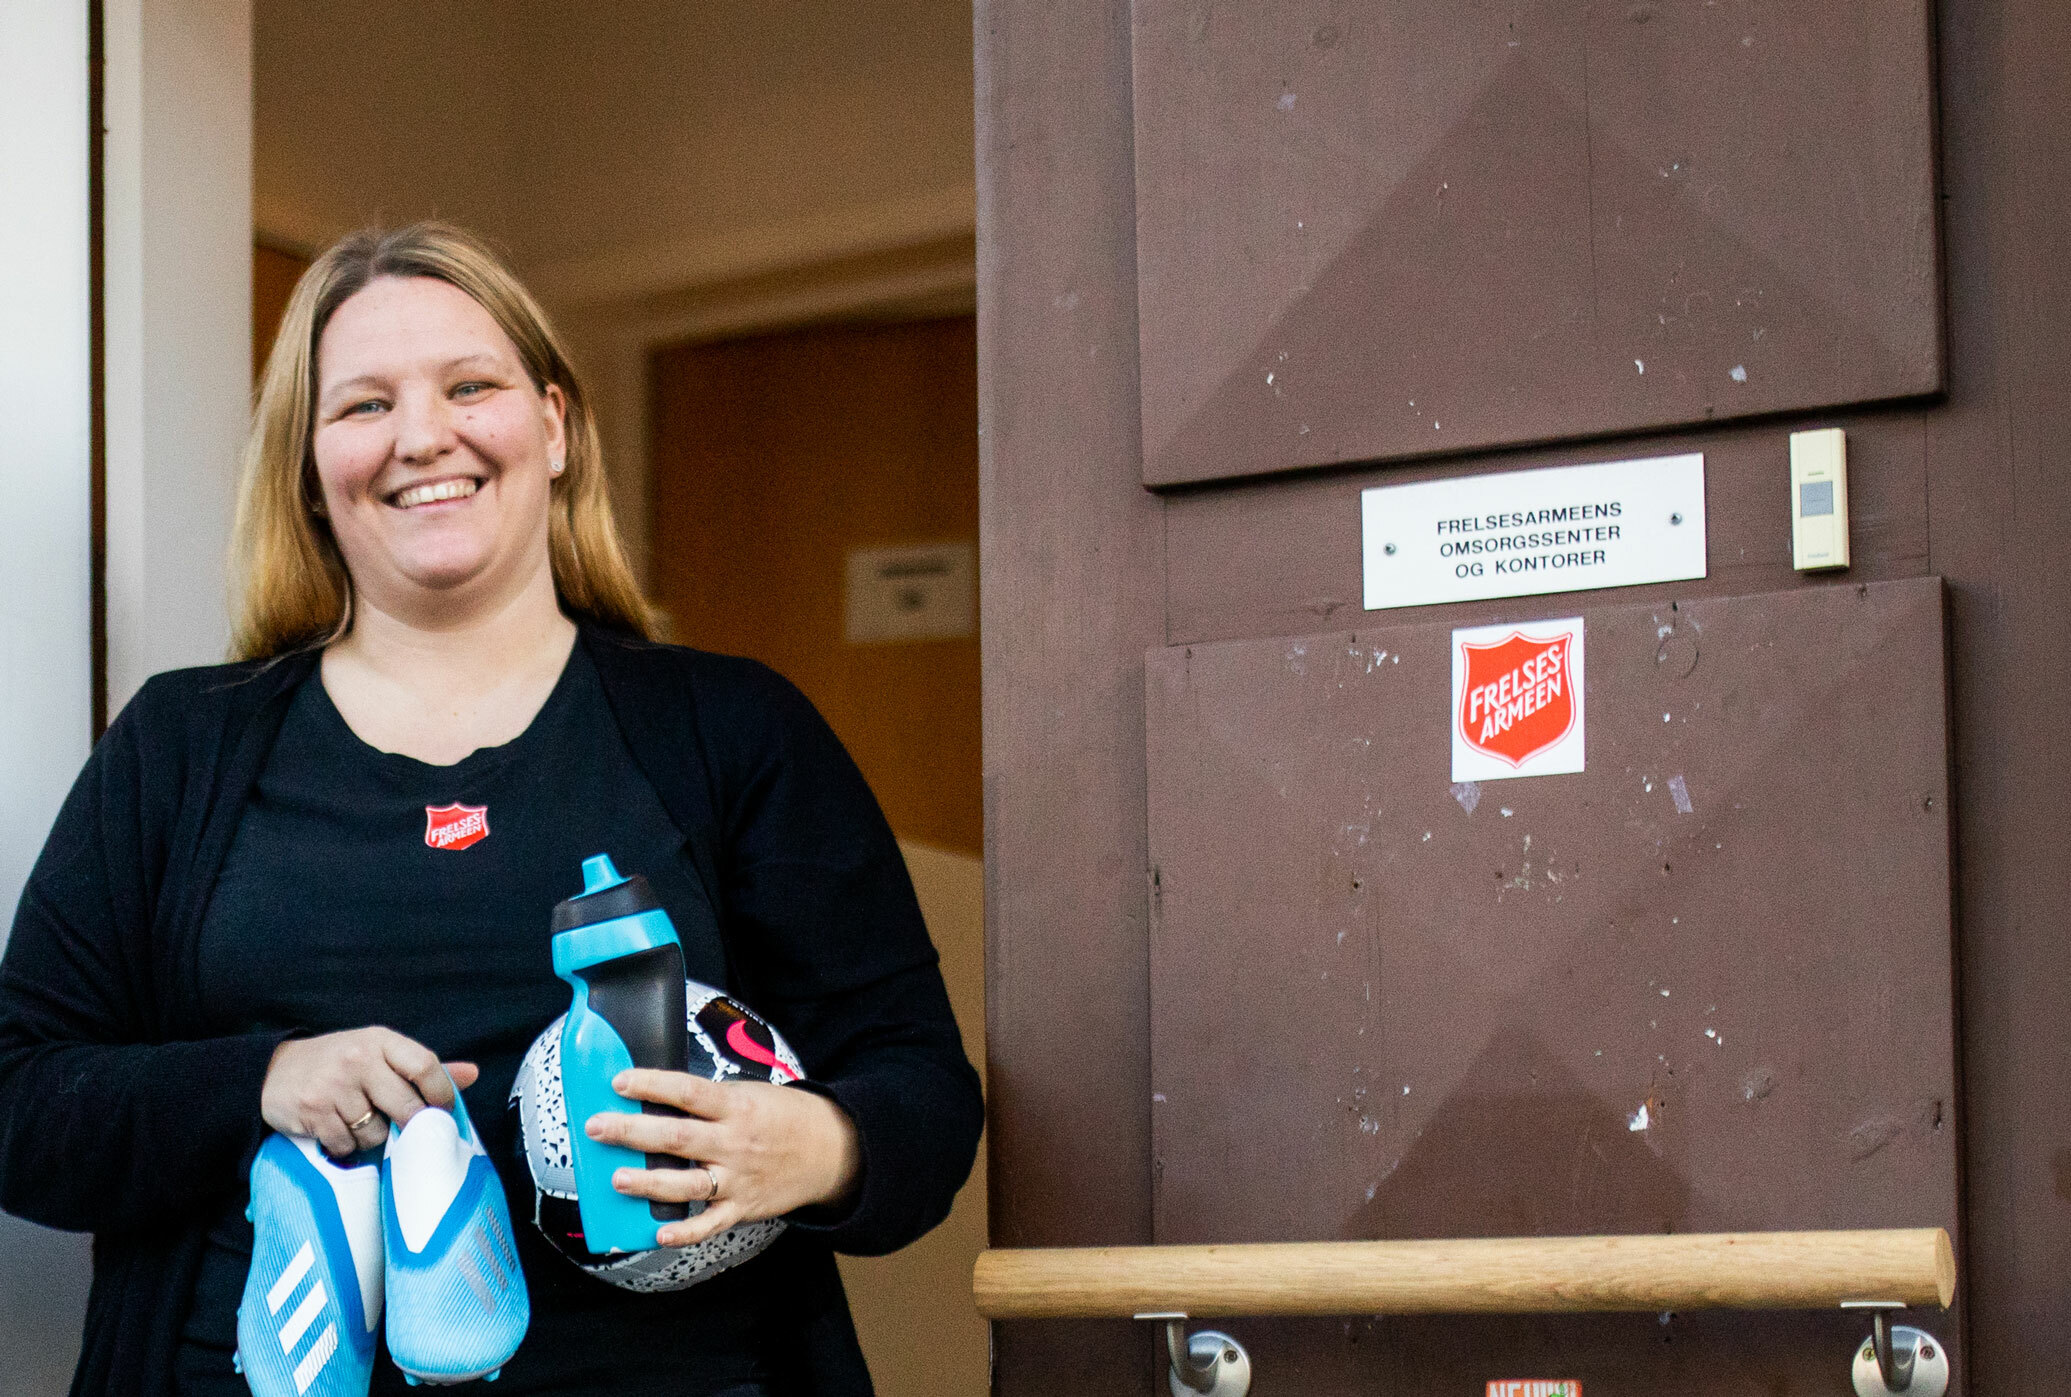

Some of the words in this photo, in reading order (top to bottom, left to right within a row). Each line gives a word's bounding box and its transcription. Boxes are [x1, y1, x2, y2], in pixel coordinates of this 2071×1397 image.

[1437, 501, 1622, 535] FRELSESARMEENS
[1440, 525, 1621, 557] OMSORGSSENTER
[1455, 562, 1484, 578] OG
[1495, 550, 1606, 574] KONTORER
[1479, 673, 1561, 745] ARMEEN
[436, 824, 481, 848] ARMEEN
